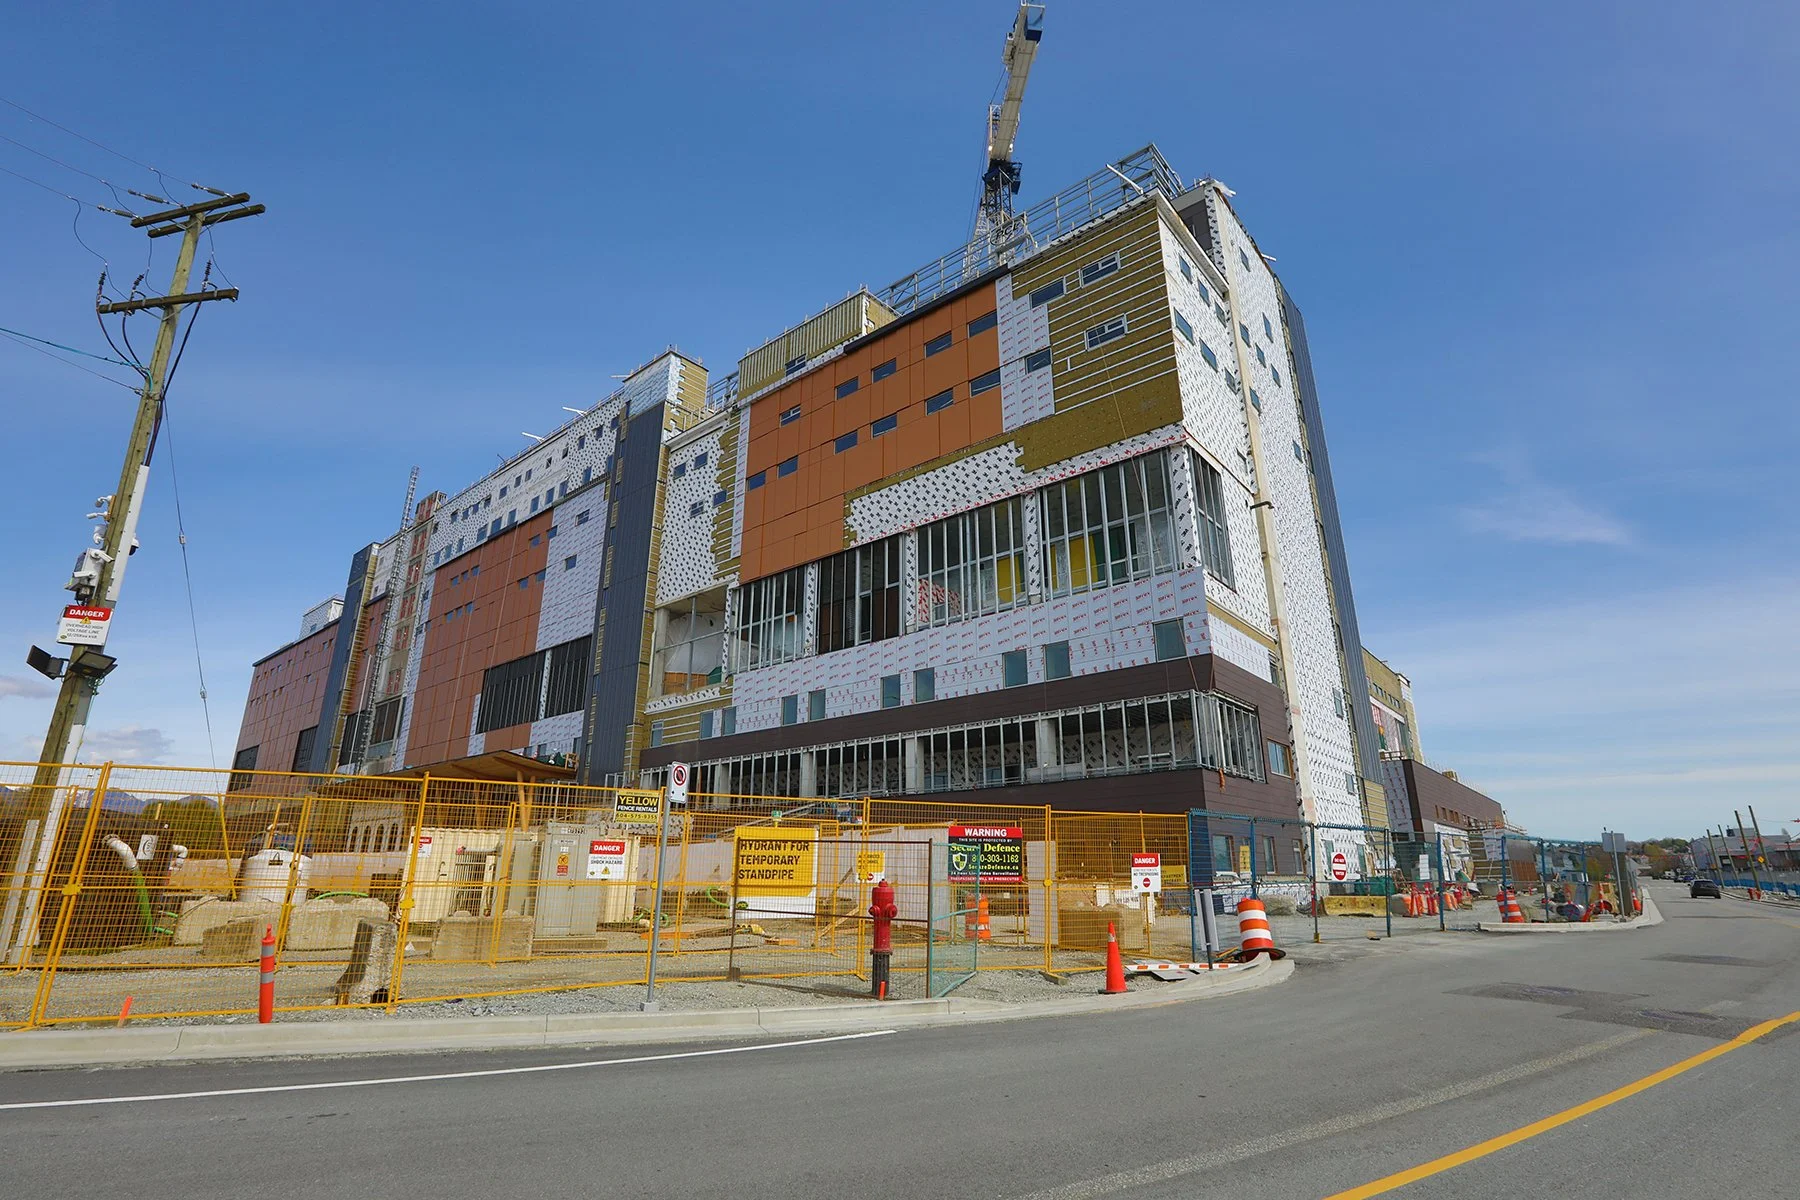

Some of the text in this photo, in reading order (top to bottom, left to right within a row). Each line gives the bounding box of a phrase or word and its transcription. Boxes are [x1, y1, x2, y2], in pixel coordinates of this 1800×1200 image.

[70, 609, 104, 617] DANGER
[620, 796, 658, 806] YELLOW
[964, 828, 1007, 836] WARNING
[740, 841, 810, 851] HYDRANT FOR
[950, 843, 1020, 852] Secur Defence
[740, 855, 800, 865] TEMPORARY
[972, 854, 1019, 863] 80-303-1162
[738, 870, 794, 879] STANDPIPE
